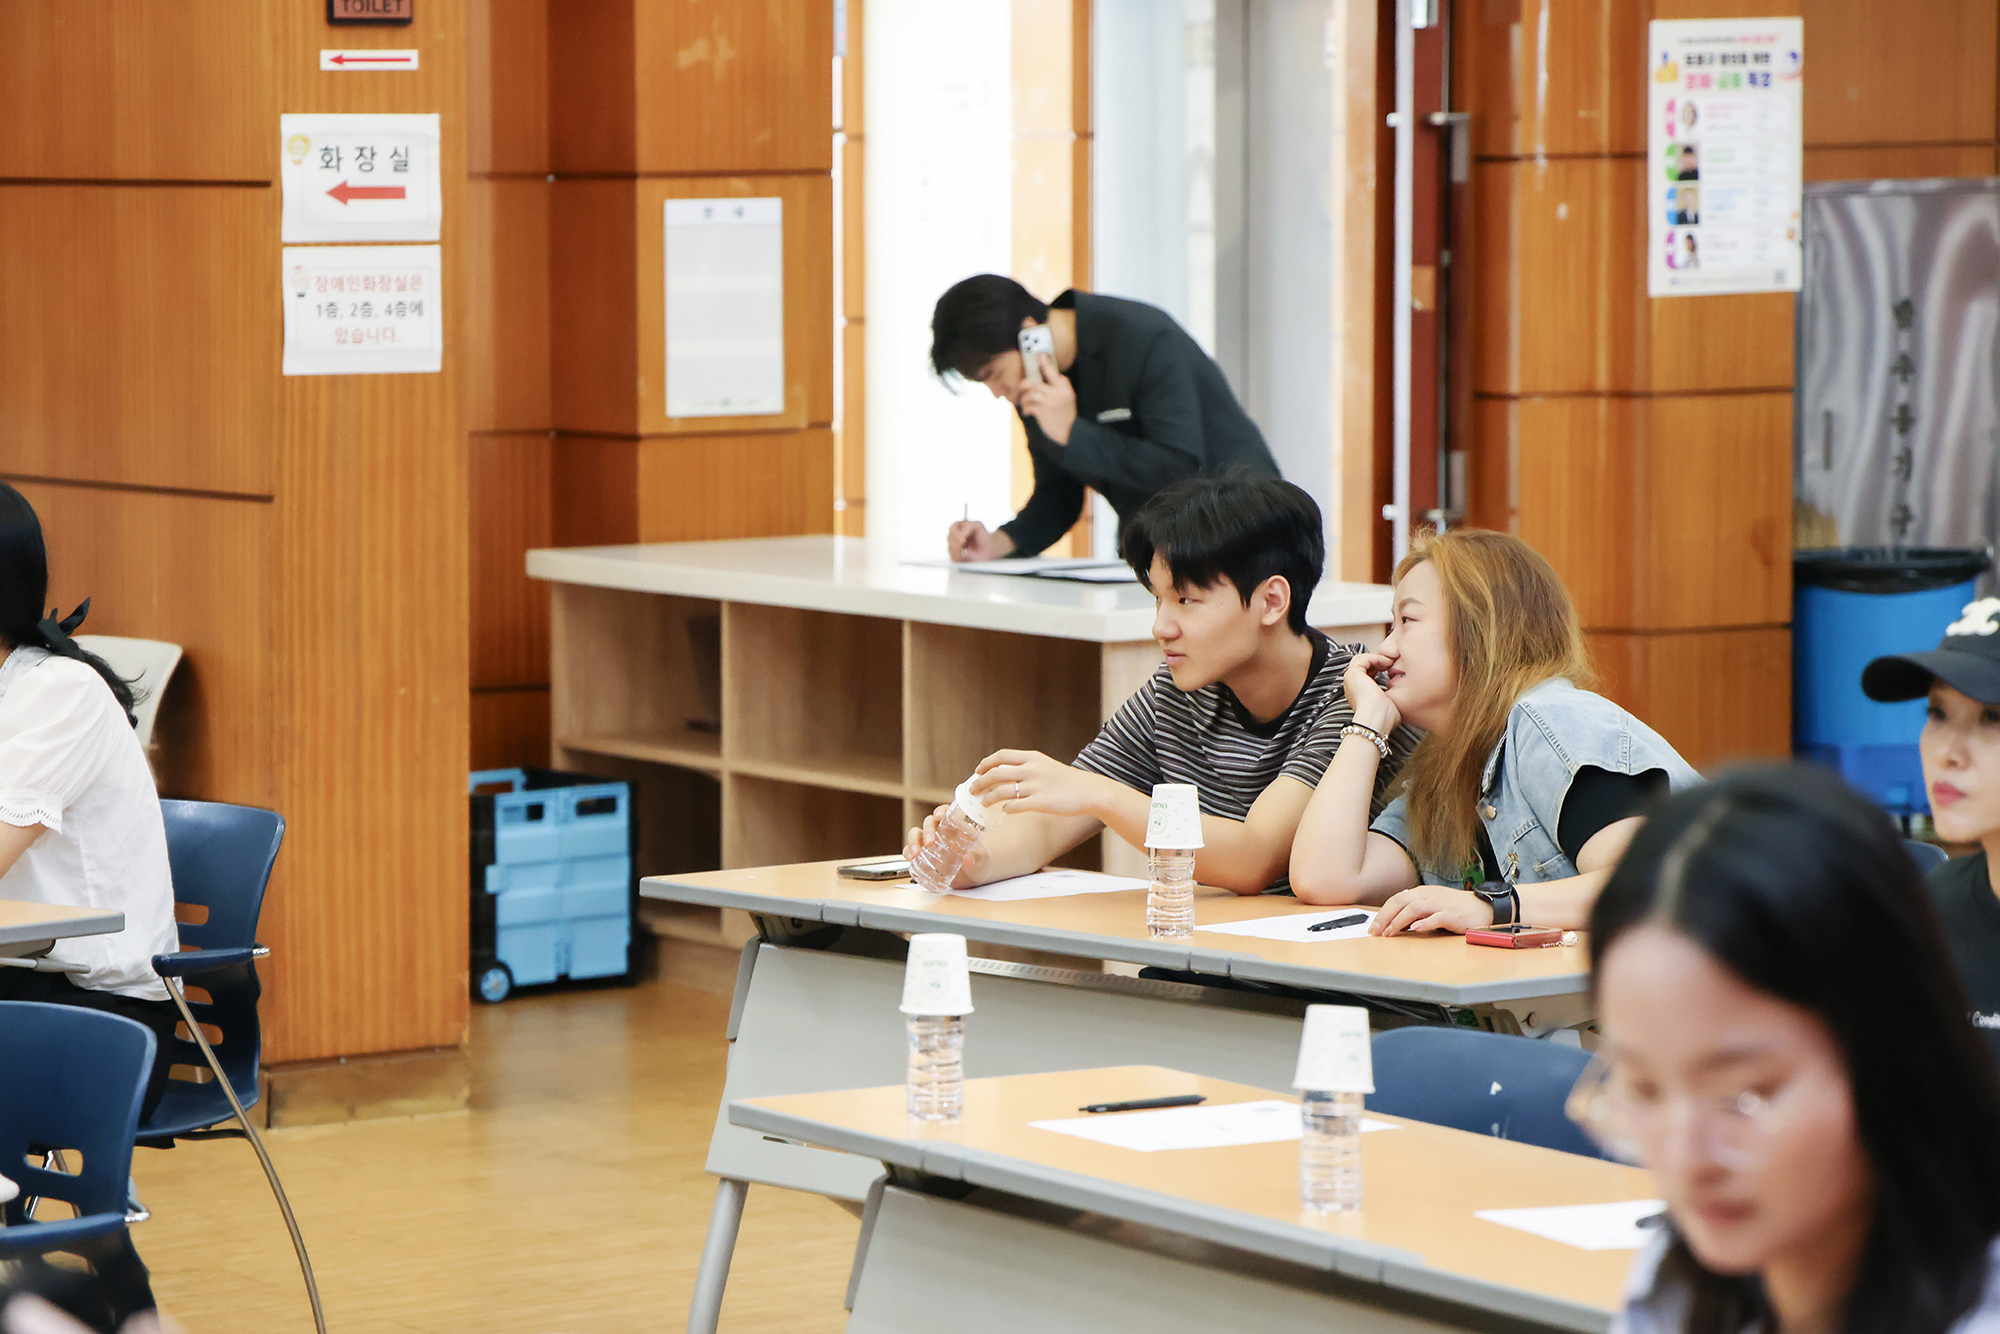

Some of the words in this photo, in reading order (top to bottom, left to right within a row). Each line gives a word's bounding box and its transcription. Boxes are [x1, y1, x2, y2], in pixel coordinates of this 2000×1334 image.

[341, 0, 404, 12] TOILET
[316, 300, 343, 319] 1층,
[350, 300, 378, 319] 2층,
[384, 300, 424, 318] 4층에
[334, 326, 401, 344] 있습니다.
